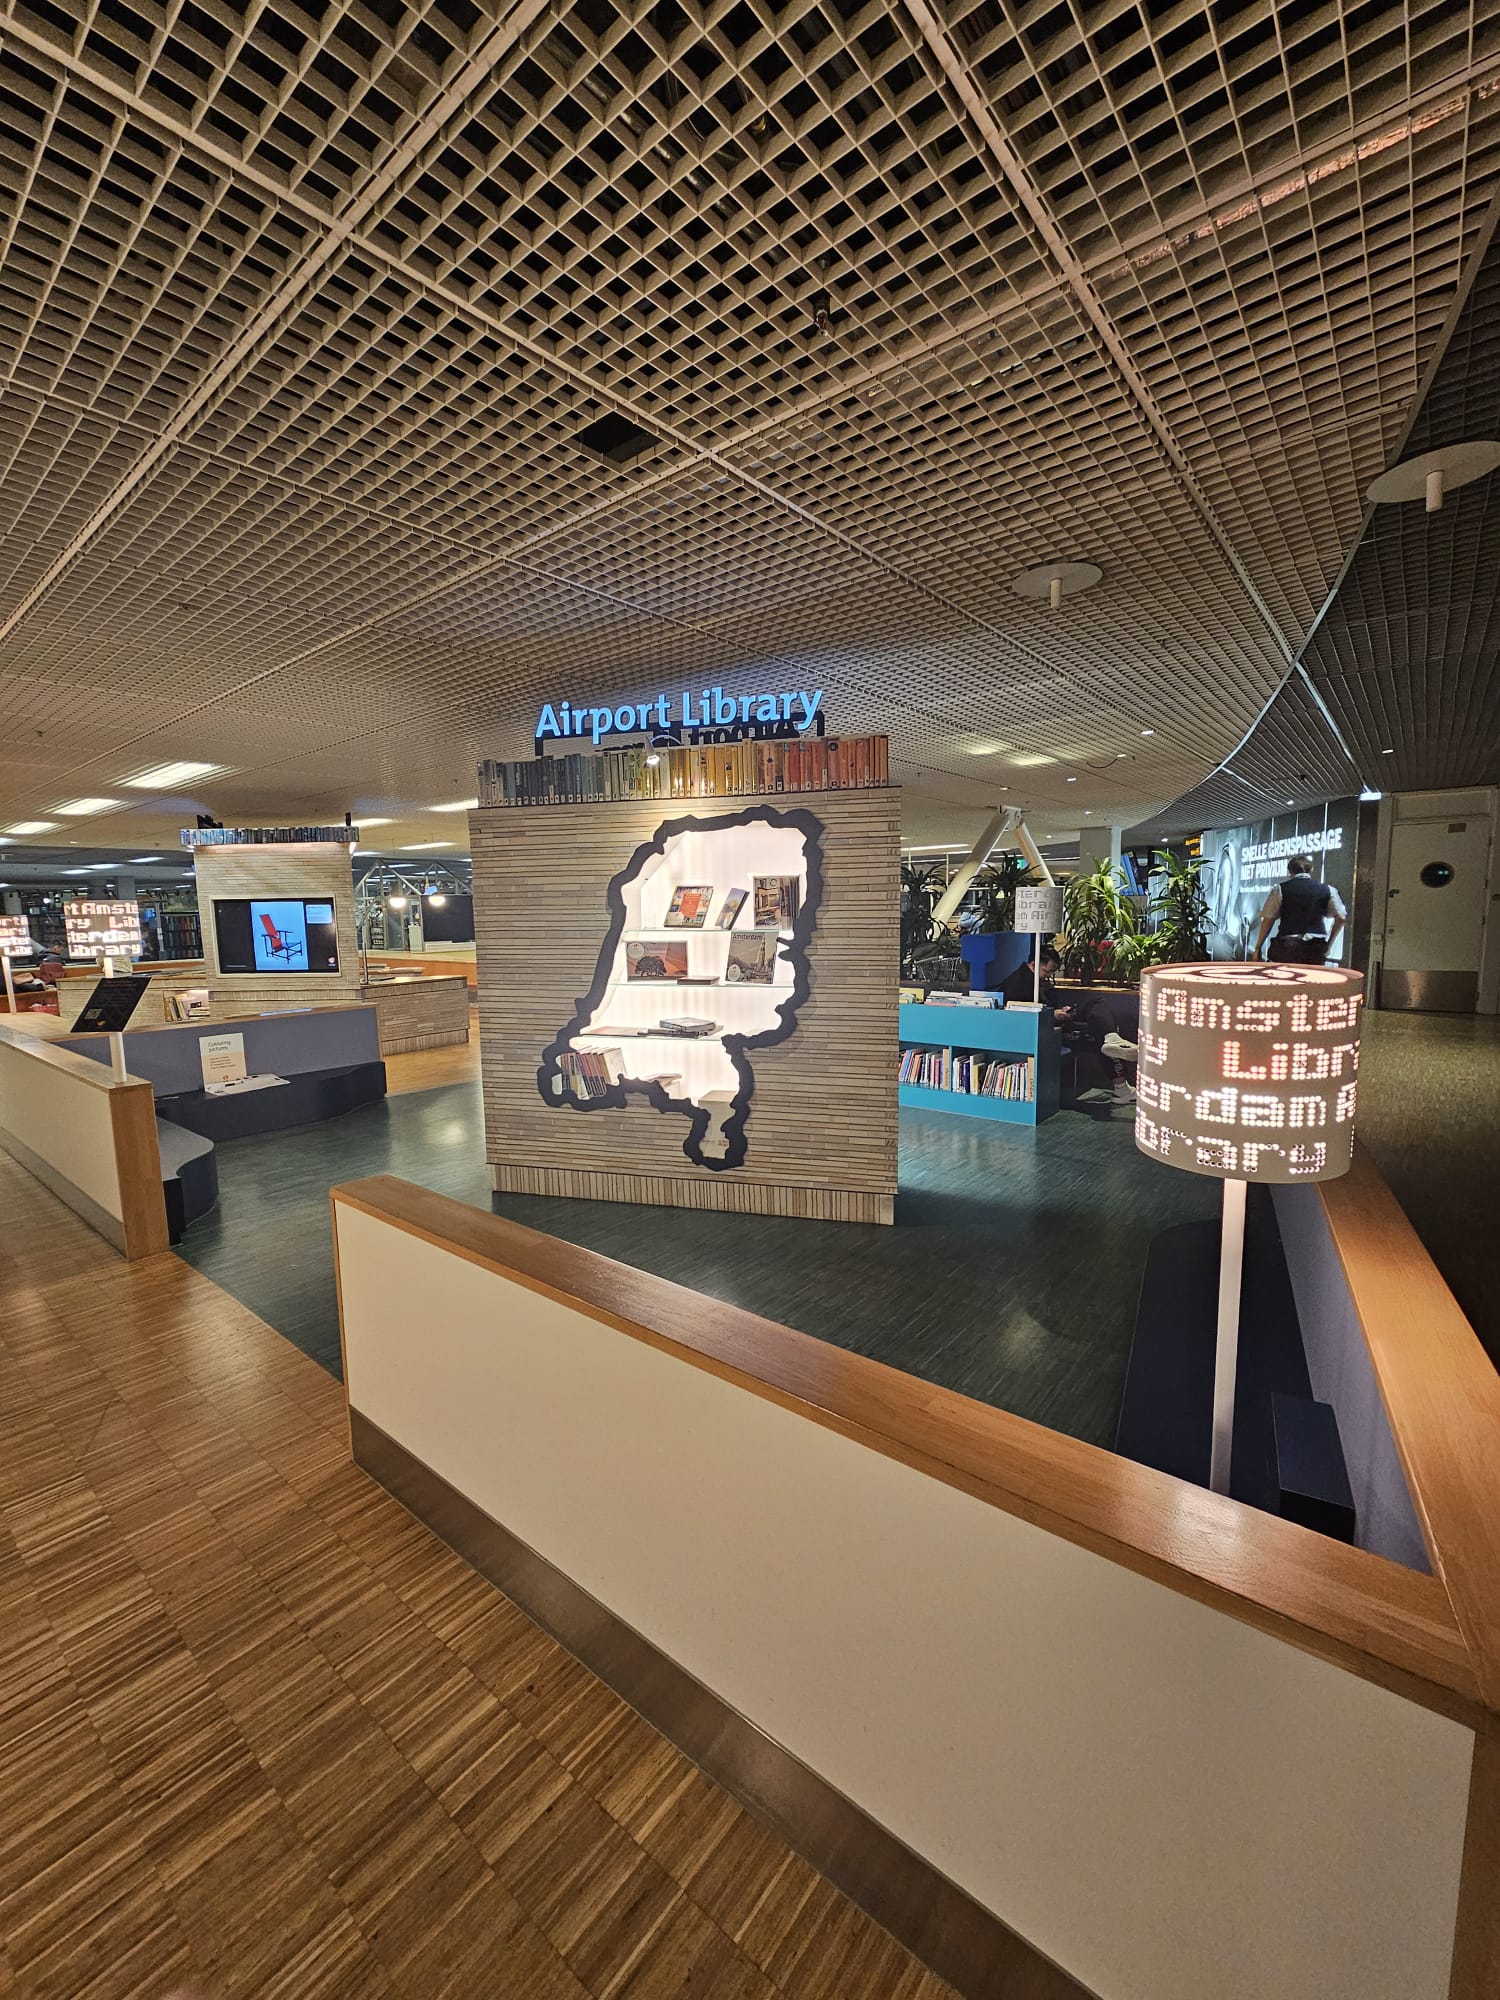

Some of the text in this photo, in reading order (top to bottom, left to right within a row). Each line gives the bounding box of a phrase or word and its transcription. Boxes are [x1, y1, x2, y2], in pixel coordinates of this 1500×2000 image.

[535, 686, 823, 745] Airport Library
[1241, 828, 1343, 863] SNELLE GRENSPASSAGE
[1256, 859, 1289, 879] PRIVIUM
[732, 933, 763, 941] Amsterdam
